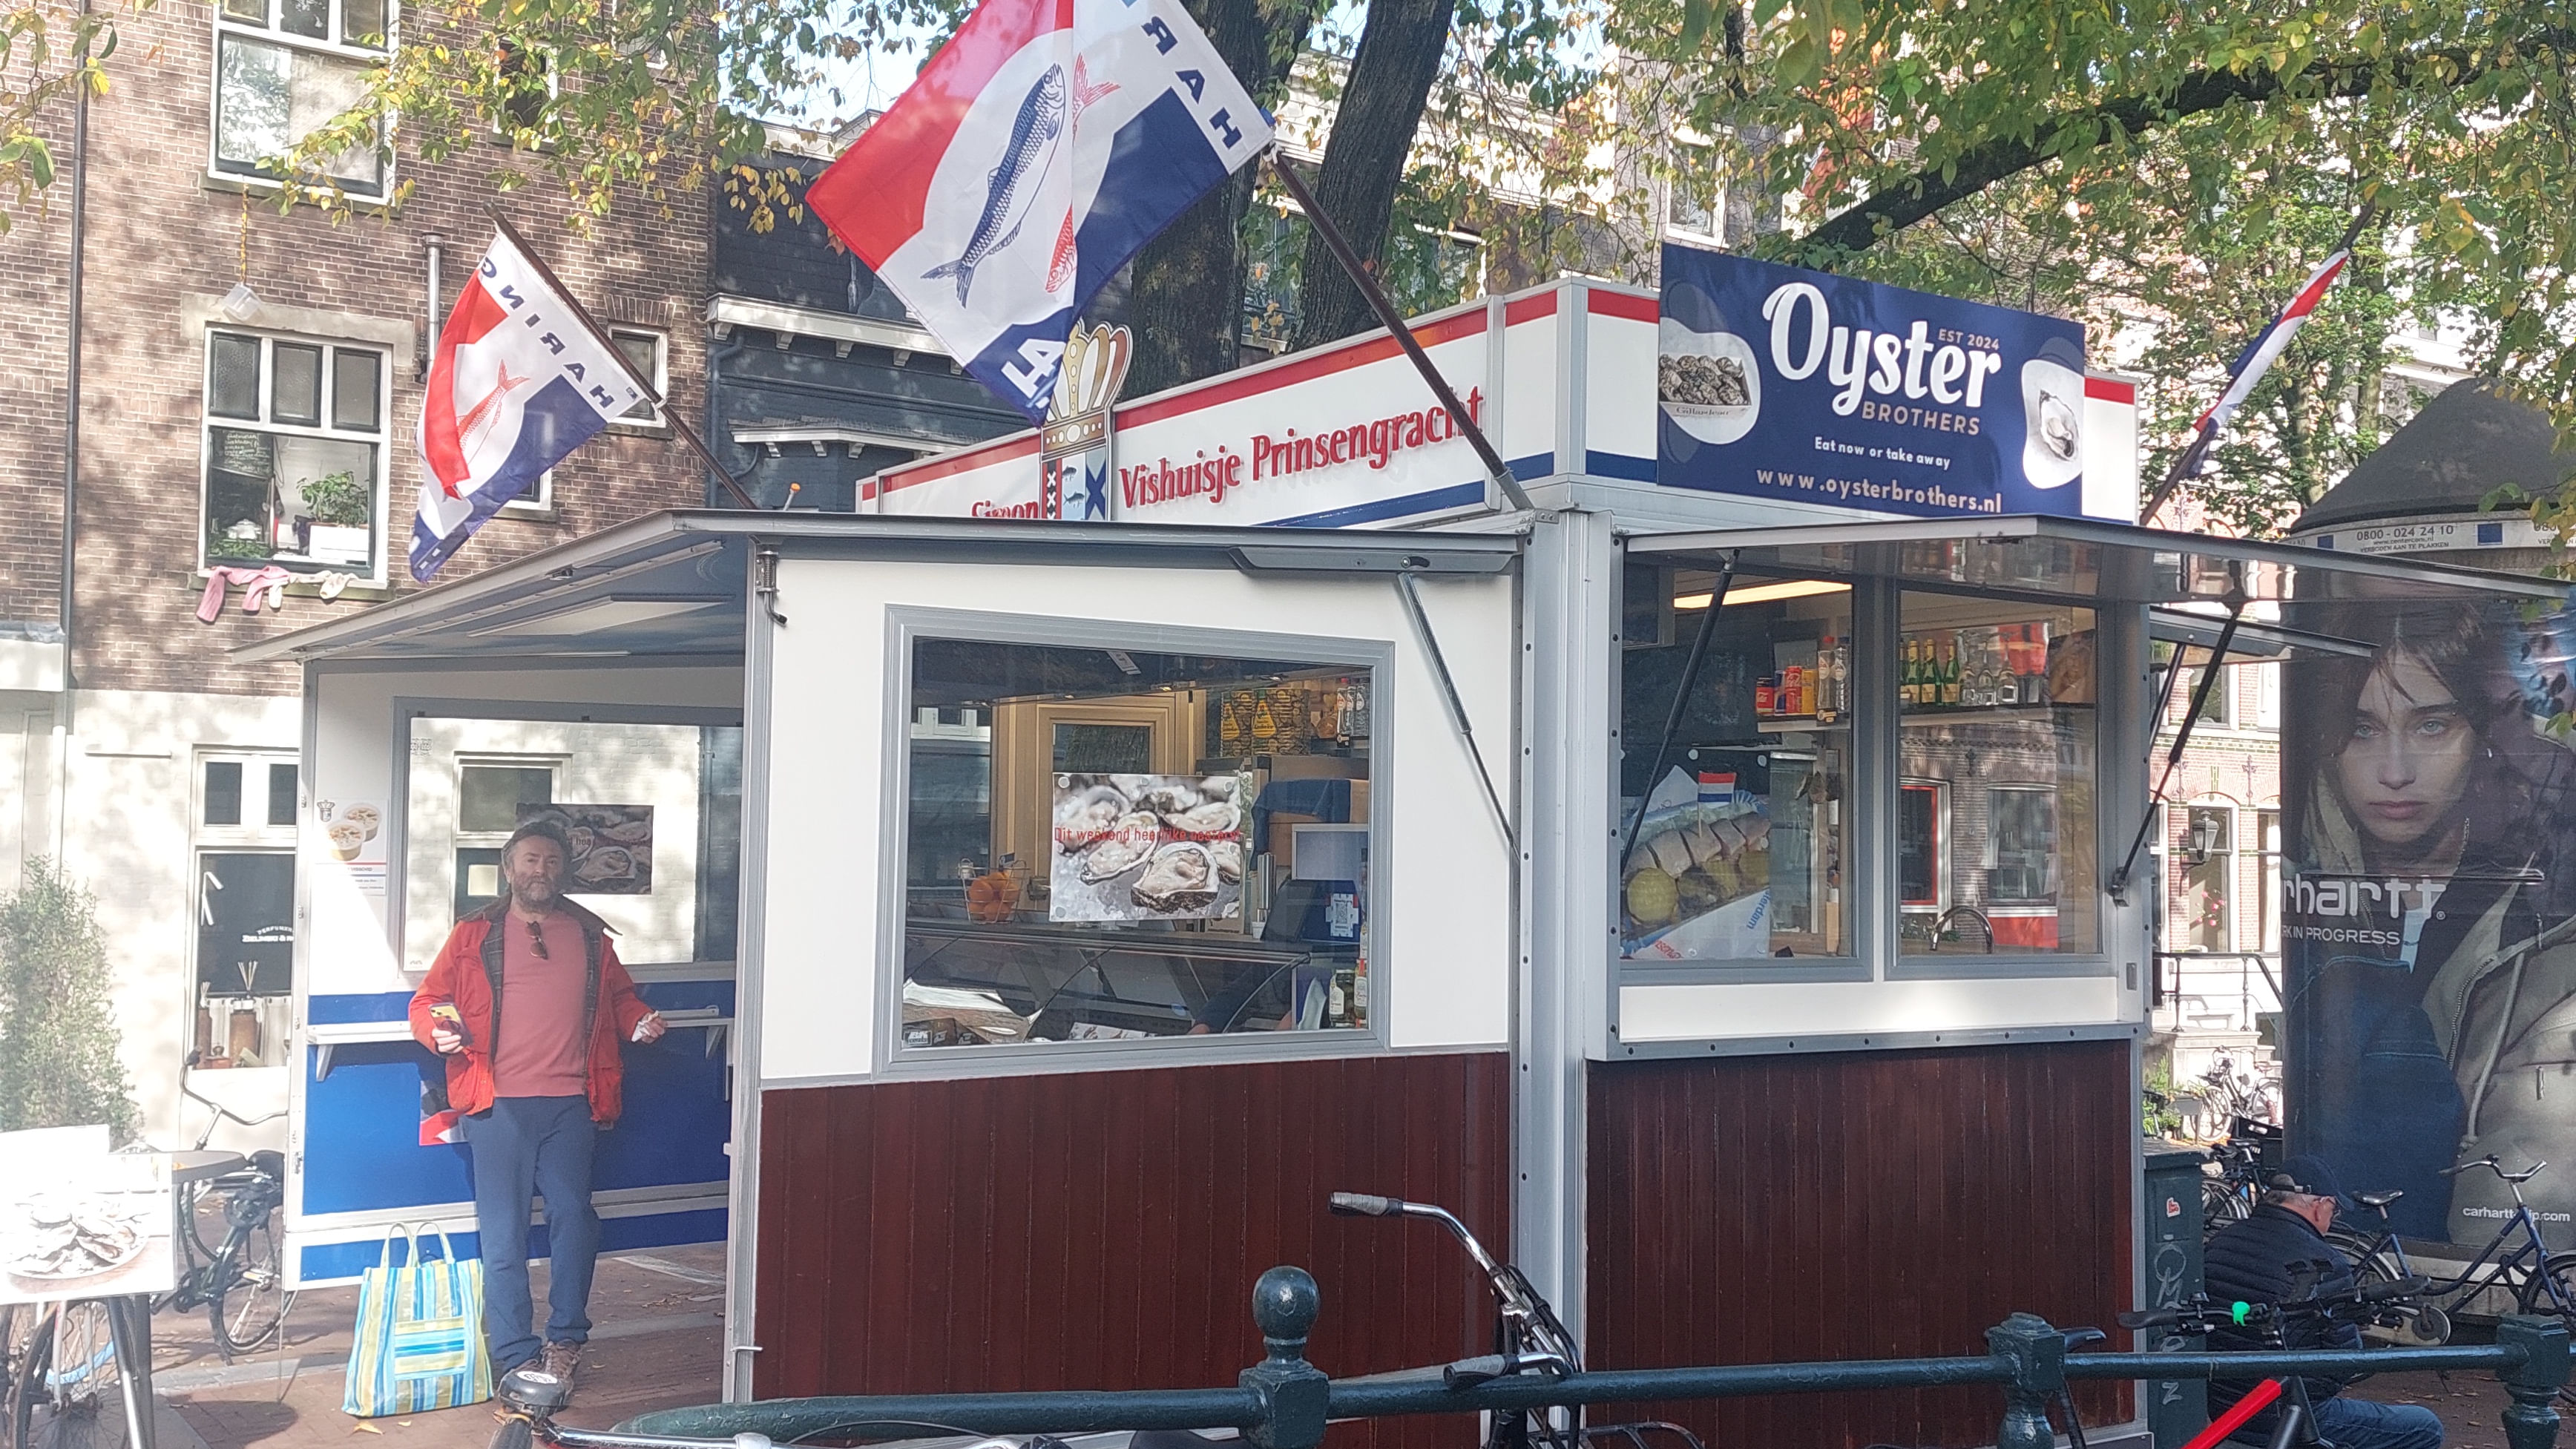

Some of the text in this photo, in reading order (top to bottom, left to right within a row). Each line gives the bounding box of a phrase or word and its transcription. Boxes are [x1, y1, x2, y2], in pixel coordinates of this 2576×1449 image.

[1762, 282, 2002, 415] Oyster
[1937, 328, 2000, 350] EST 2024
[1862, 401, 1980, 436] BROTHERS
[1815, 436, 1951, 470] Eat now or take away
[1119, 444, 1240, 507] Vishuisje
[1756, 469, 2002, 513] www.oysterbrothers.nl
[2356, 529, 2384, 541] 0800
[2393, 528, 2415, 538] 024
[2420, 526, 2435, 536] 24
[2440, 525, 2454, 534] 10
[1054, 827, 1072, 841] Dit
[1077, 828, 1130, 842] weekend
[2293, 927, 2303, 939] IN
[2307, 927, 2401, 945] PROGRESS
[2462, 1206, 2571, 1222] carhartt-ip.com
